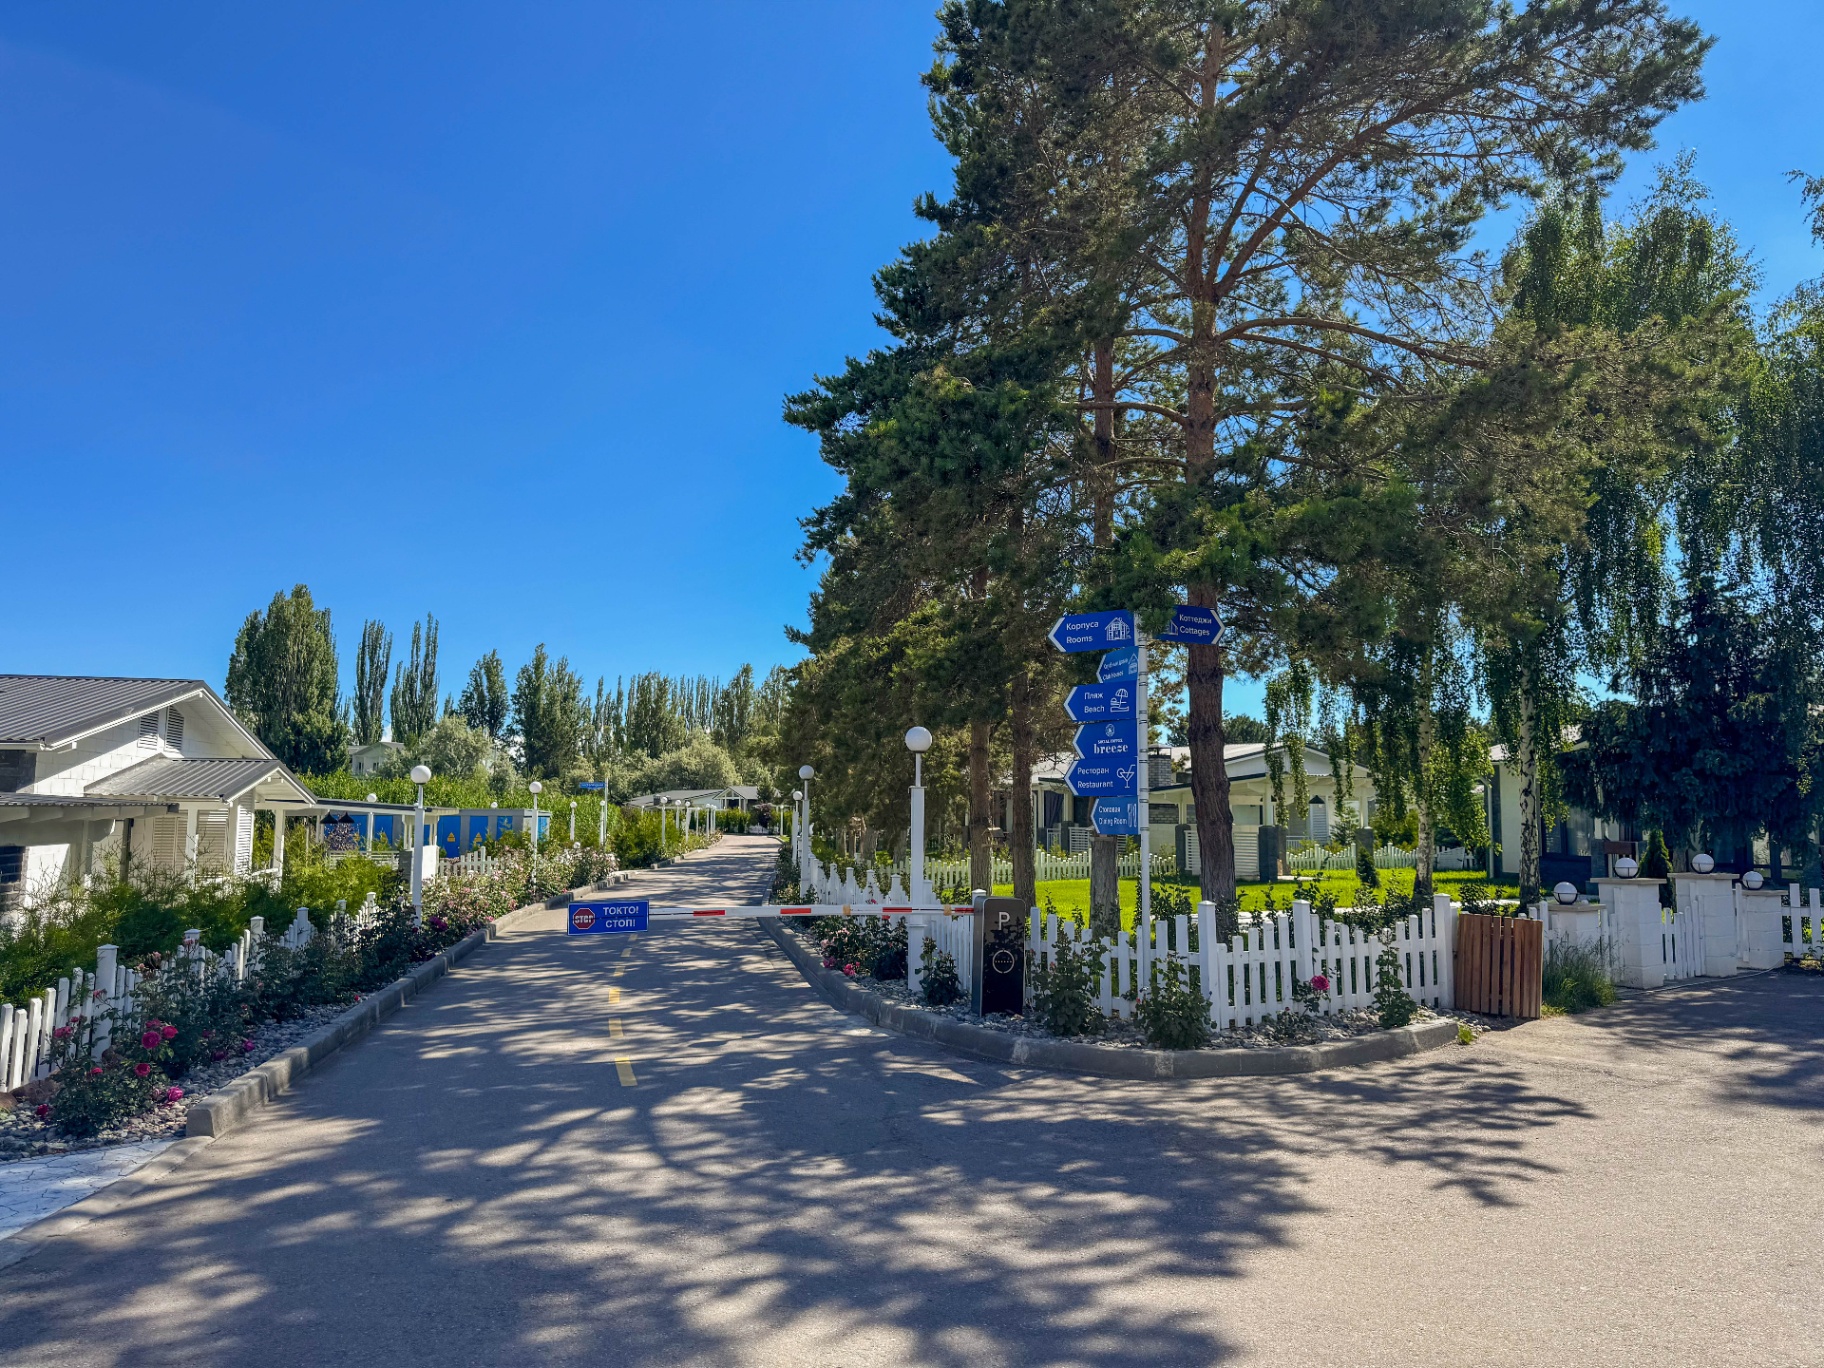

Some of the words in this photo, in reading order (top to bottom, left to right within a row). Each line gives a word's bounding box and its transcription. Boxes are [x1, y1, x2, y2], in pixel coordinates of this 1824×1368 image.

[1179, 614, 1212, 624] Коттеджи
[1066, 621, 1099, 631] Корпуса
[1179, 626, 1210, 636] Cottages
[1066, 635, 1093, 644] Rooms
[1084, 692, 1104, 700] Пляж
[1084, 705, 1105, 713] Beach
[1093, 743, 1129, 754] breeze
[1077, 767, 1110, 775] Ресторан
[1077, 781, 1114, 789] Restaurant
[1114, 817, 1128, 825] Room
[602, 905, 639, 915] ТОКТО!
[574, 915, 594, 924] STOP
[605, 918, 636, 928] СТОП!
[998, 911, 1011, 931] P
